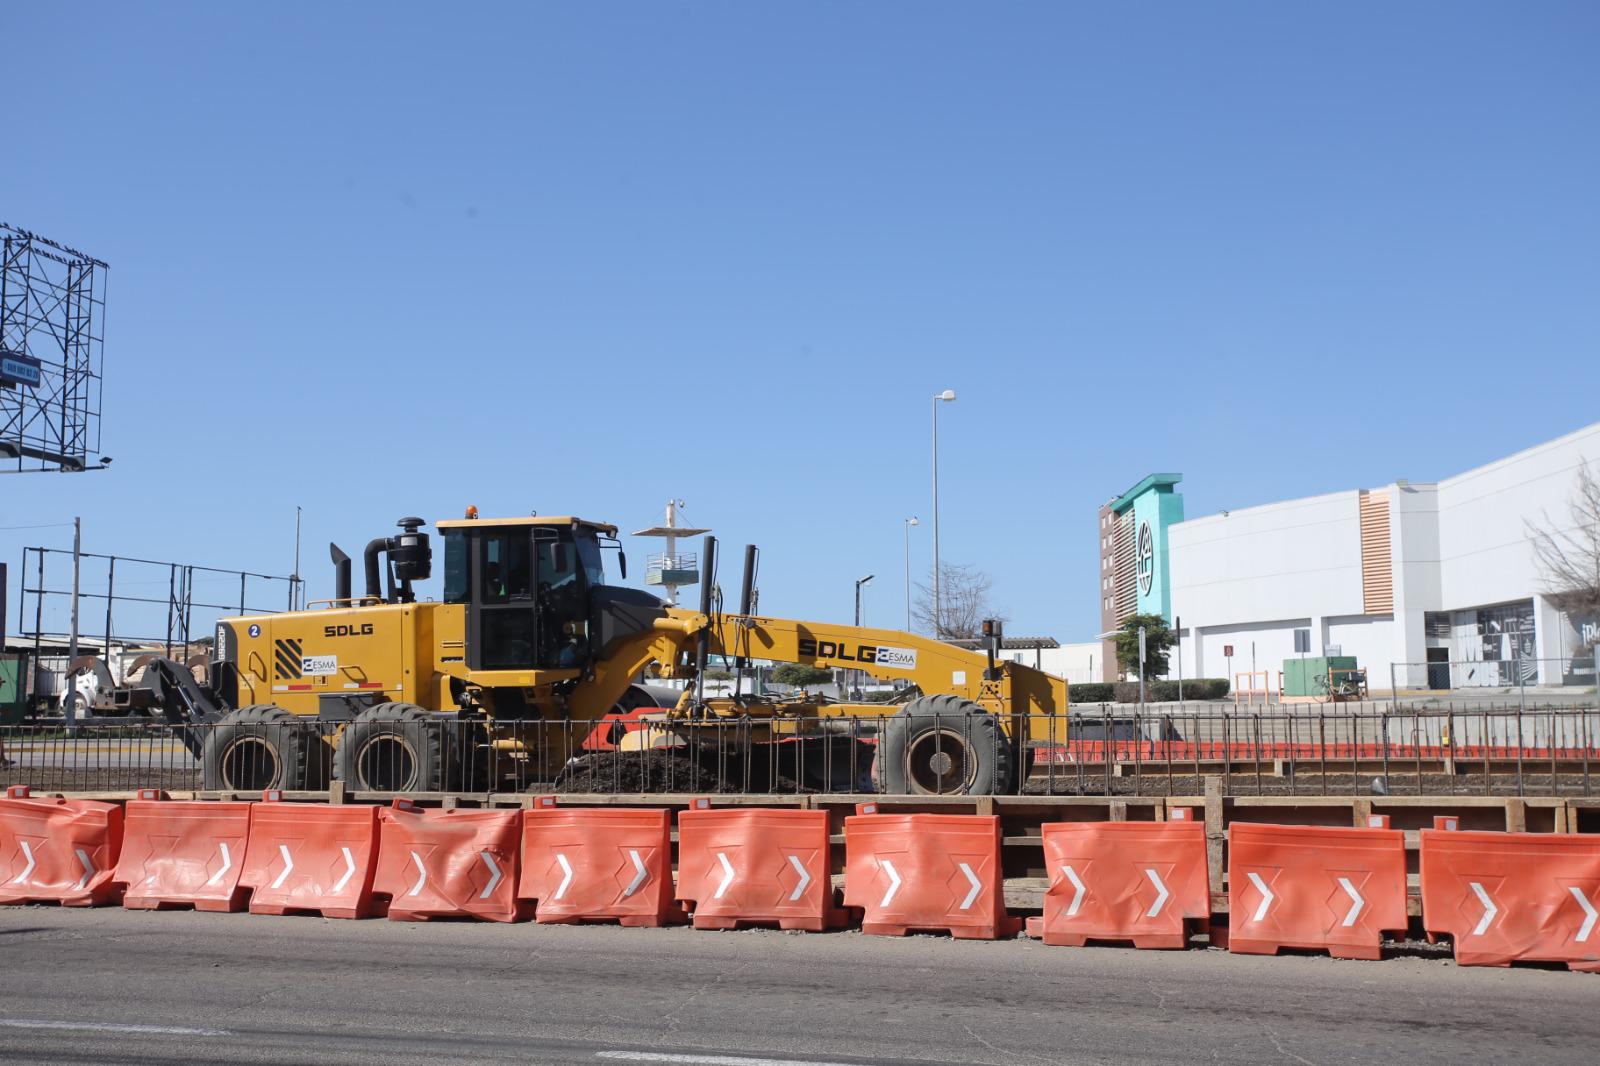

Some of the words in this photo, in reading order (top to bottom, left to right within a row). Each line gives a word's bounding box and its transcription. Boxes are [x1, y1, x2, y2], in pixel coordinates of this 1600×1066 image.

[251, 625, 258, 637] 2
[324, 623, 374, 638] SDLG
[218, 625, 226, 661] G9220F
[798, 638, 877, 664] SDLG
[888, 652, 915, 664] ESMA
[312, 660, 336, 670] ESMA
